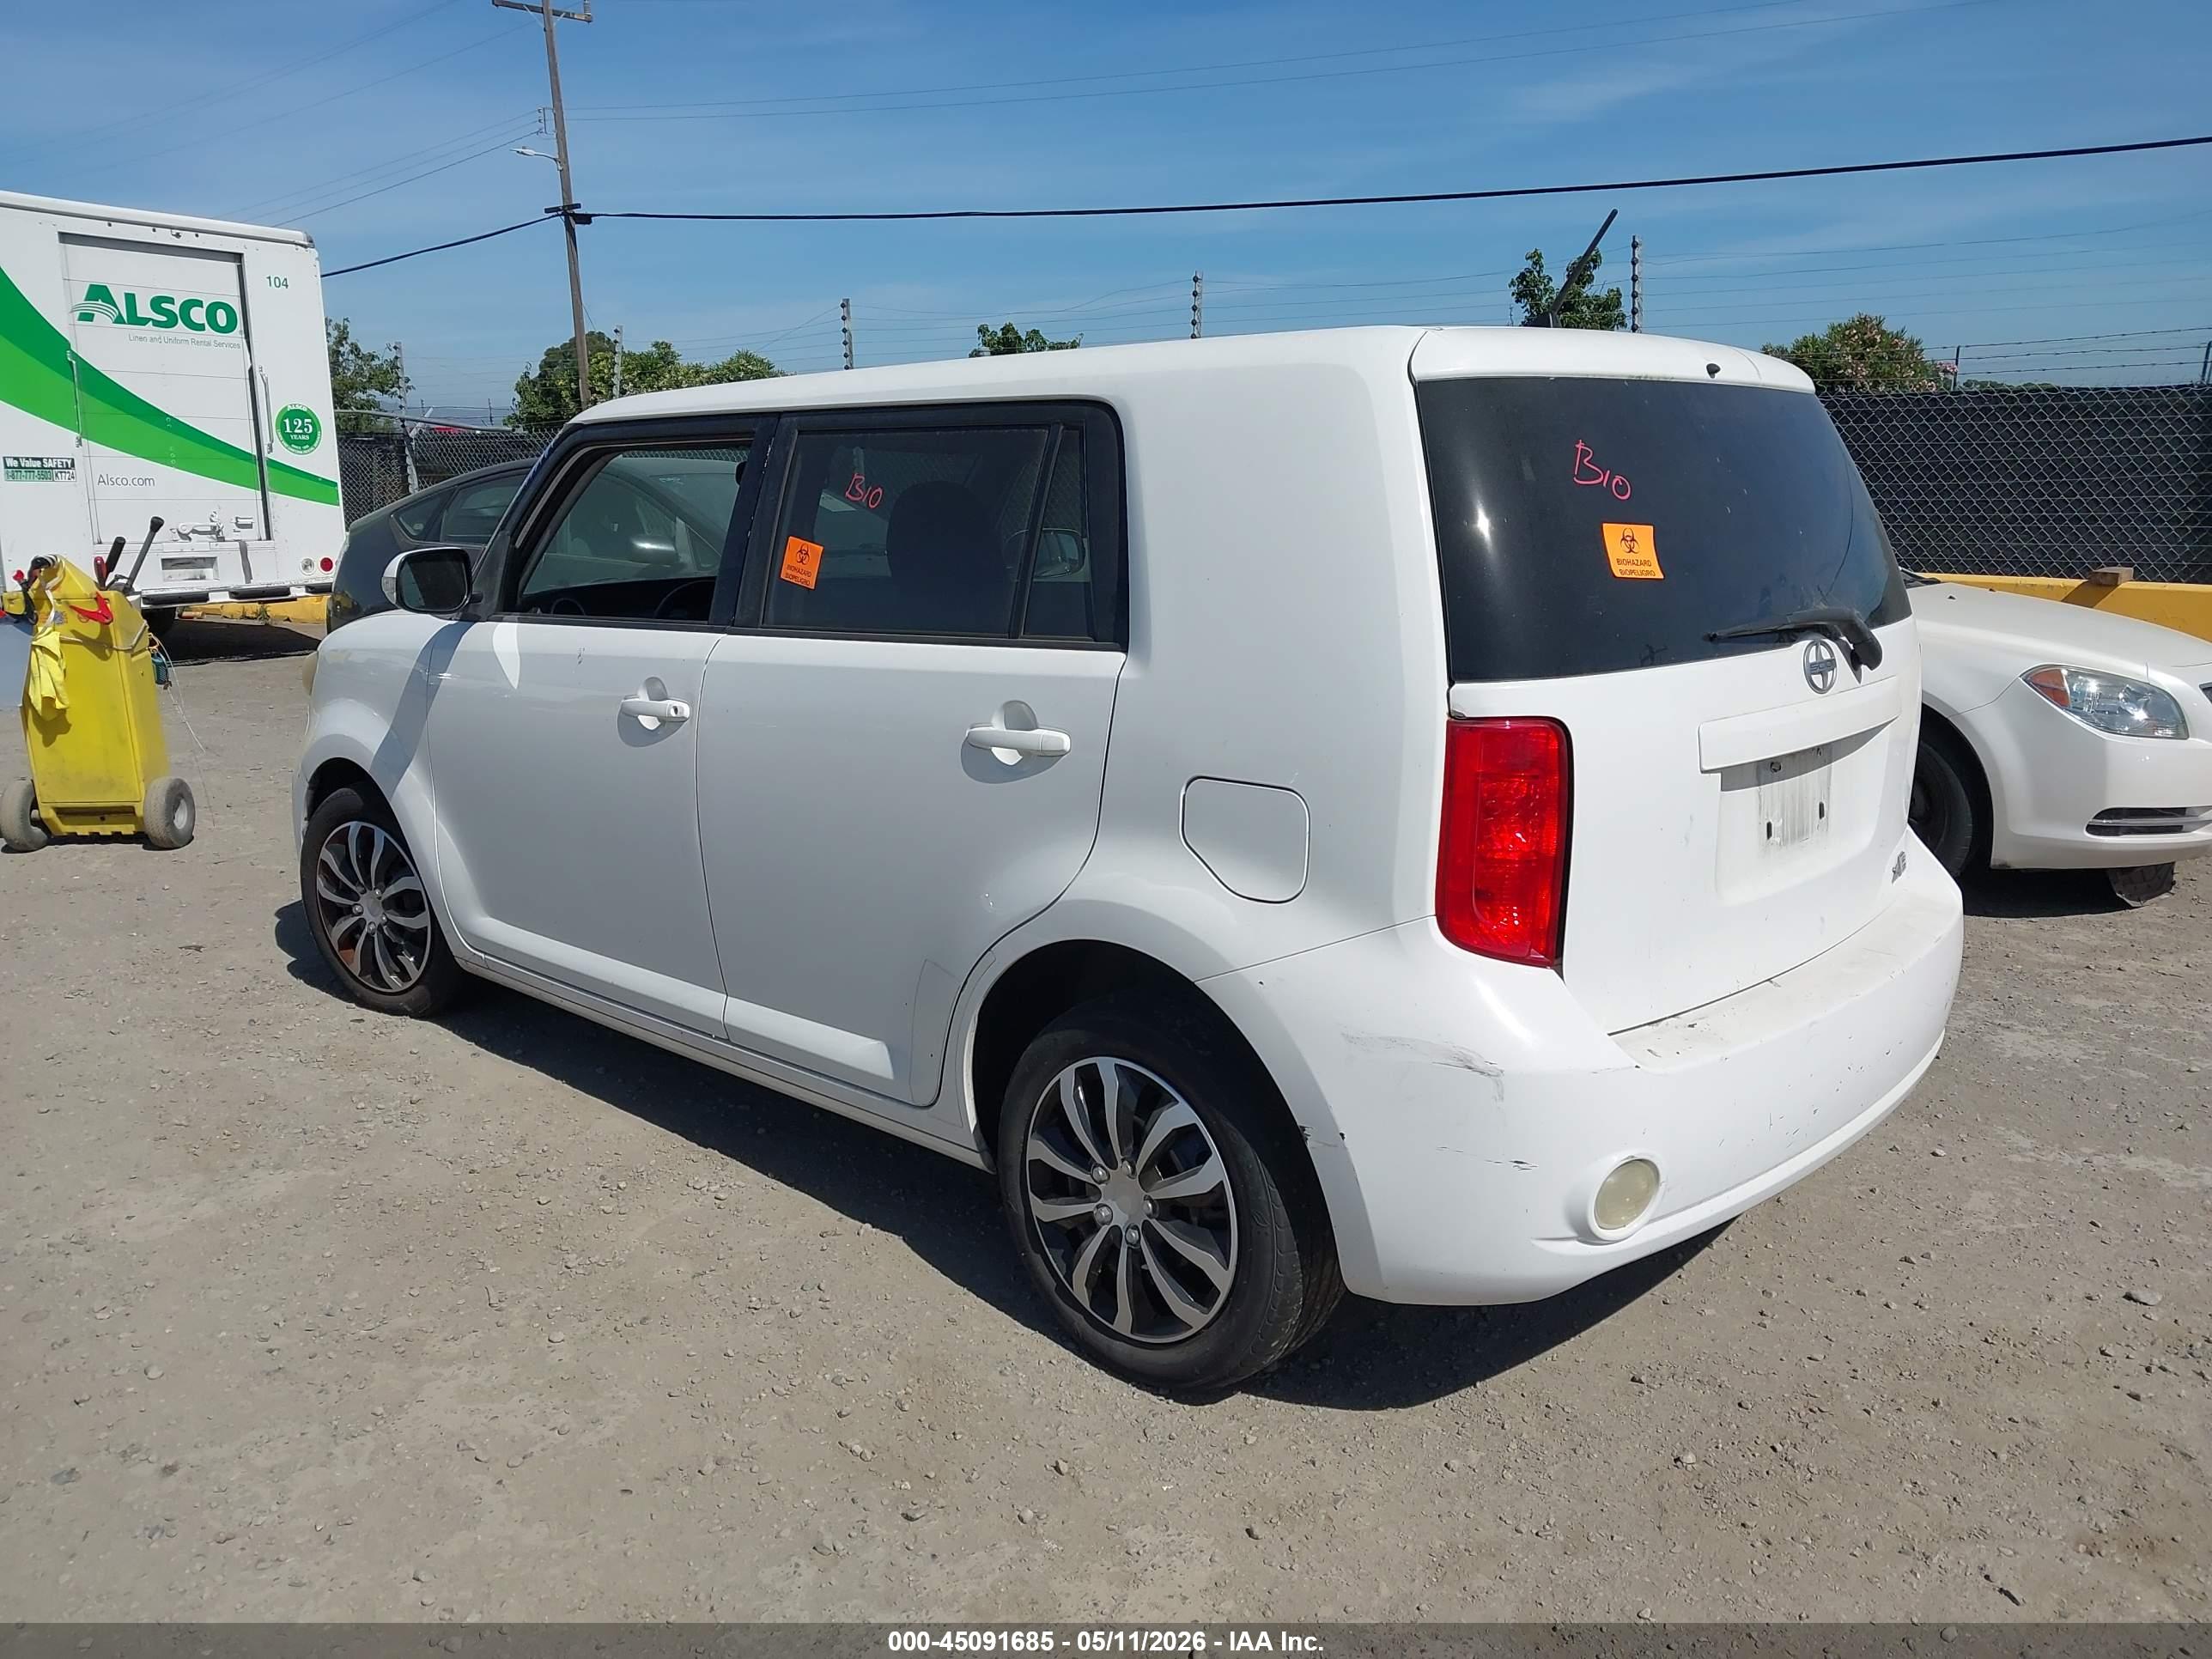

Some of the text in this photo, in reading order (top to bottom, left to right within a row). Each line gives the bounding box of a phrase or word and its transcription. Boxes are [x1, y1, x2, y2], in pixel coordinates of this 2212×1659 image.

[266, 275, 289, 289] 104
[71, 283, 238, 334] ALSCO
[128, 332, 241, 349] Linen and Uniform Rental Services
[283, 418, 313, 434] 125
[5, 458, 72, 468] We Value SAFETY
[97, 473, 155, 487] Alsco.com
[1616, 558, 1652, 567] BIOHAZARD
[787, 564, 812, 577] BIOHAZARD
[1619, 568, 1656, 577] BIOPELIGRO
